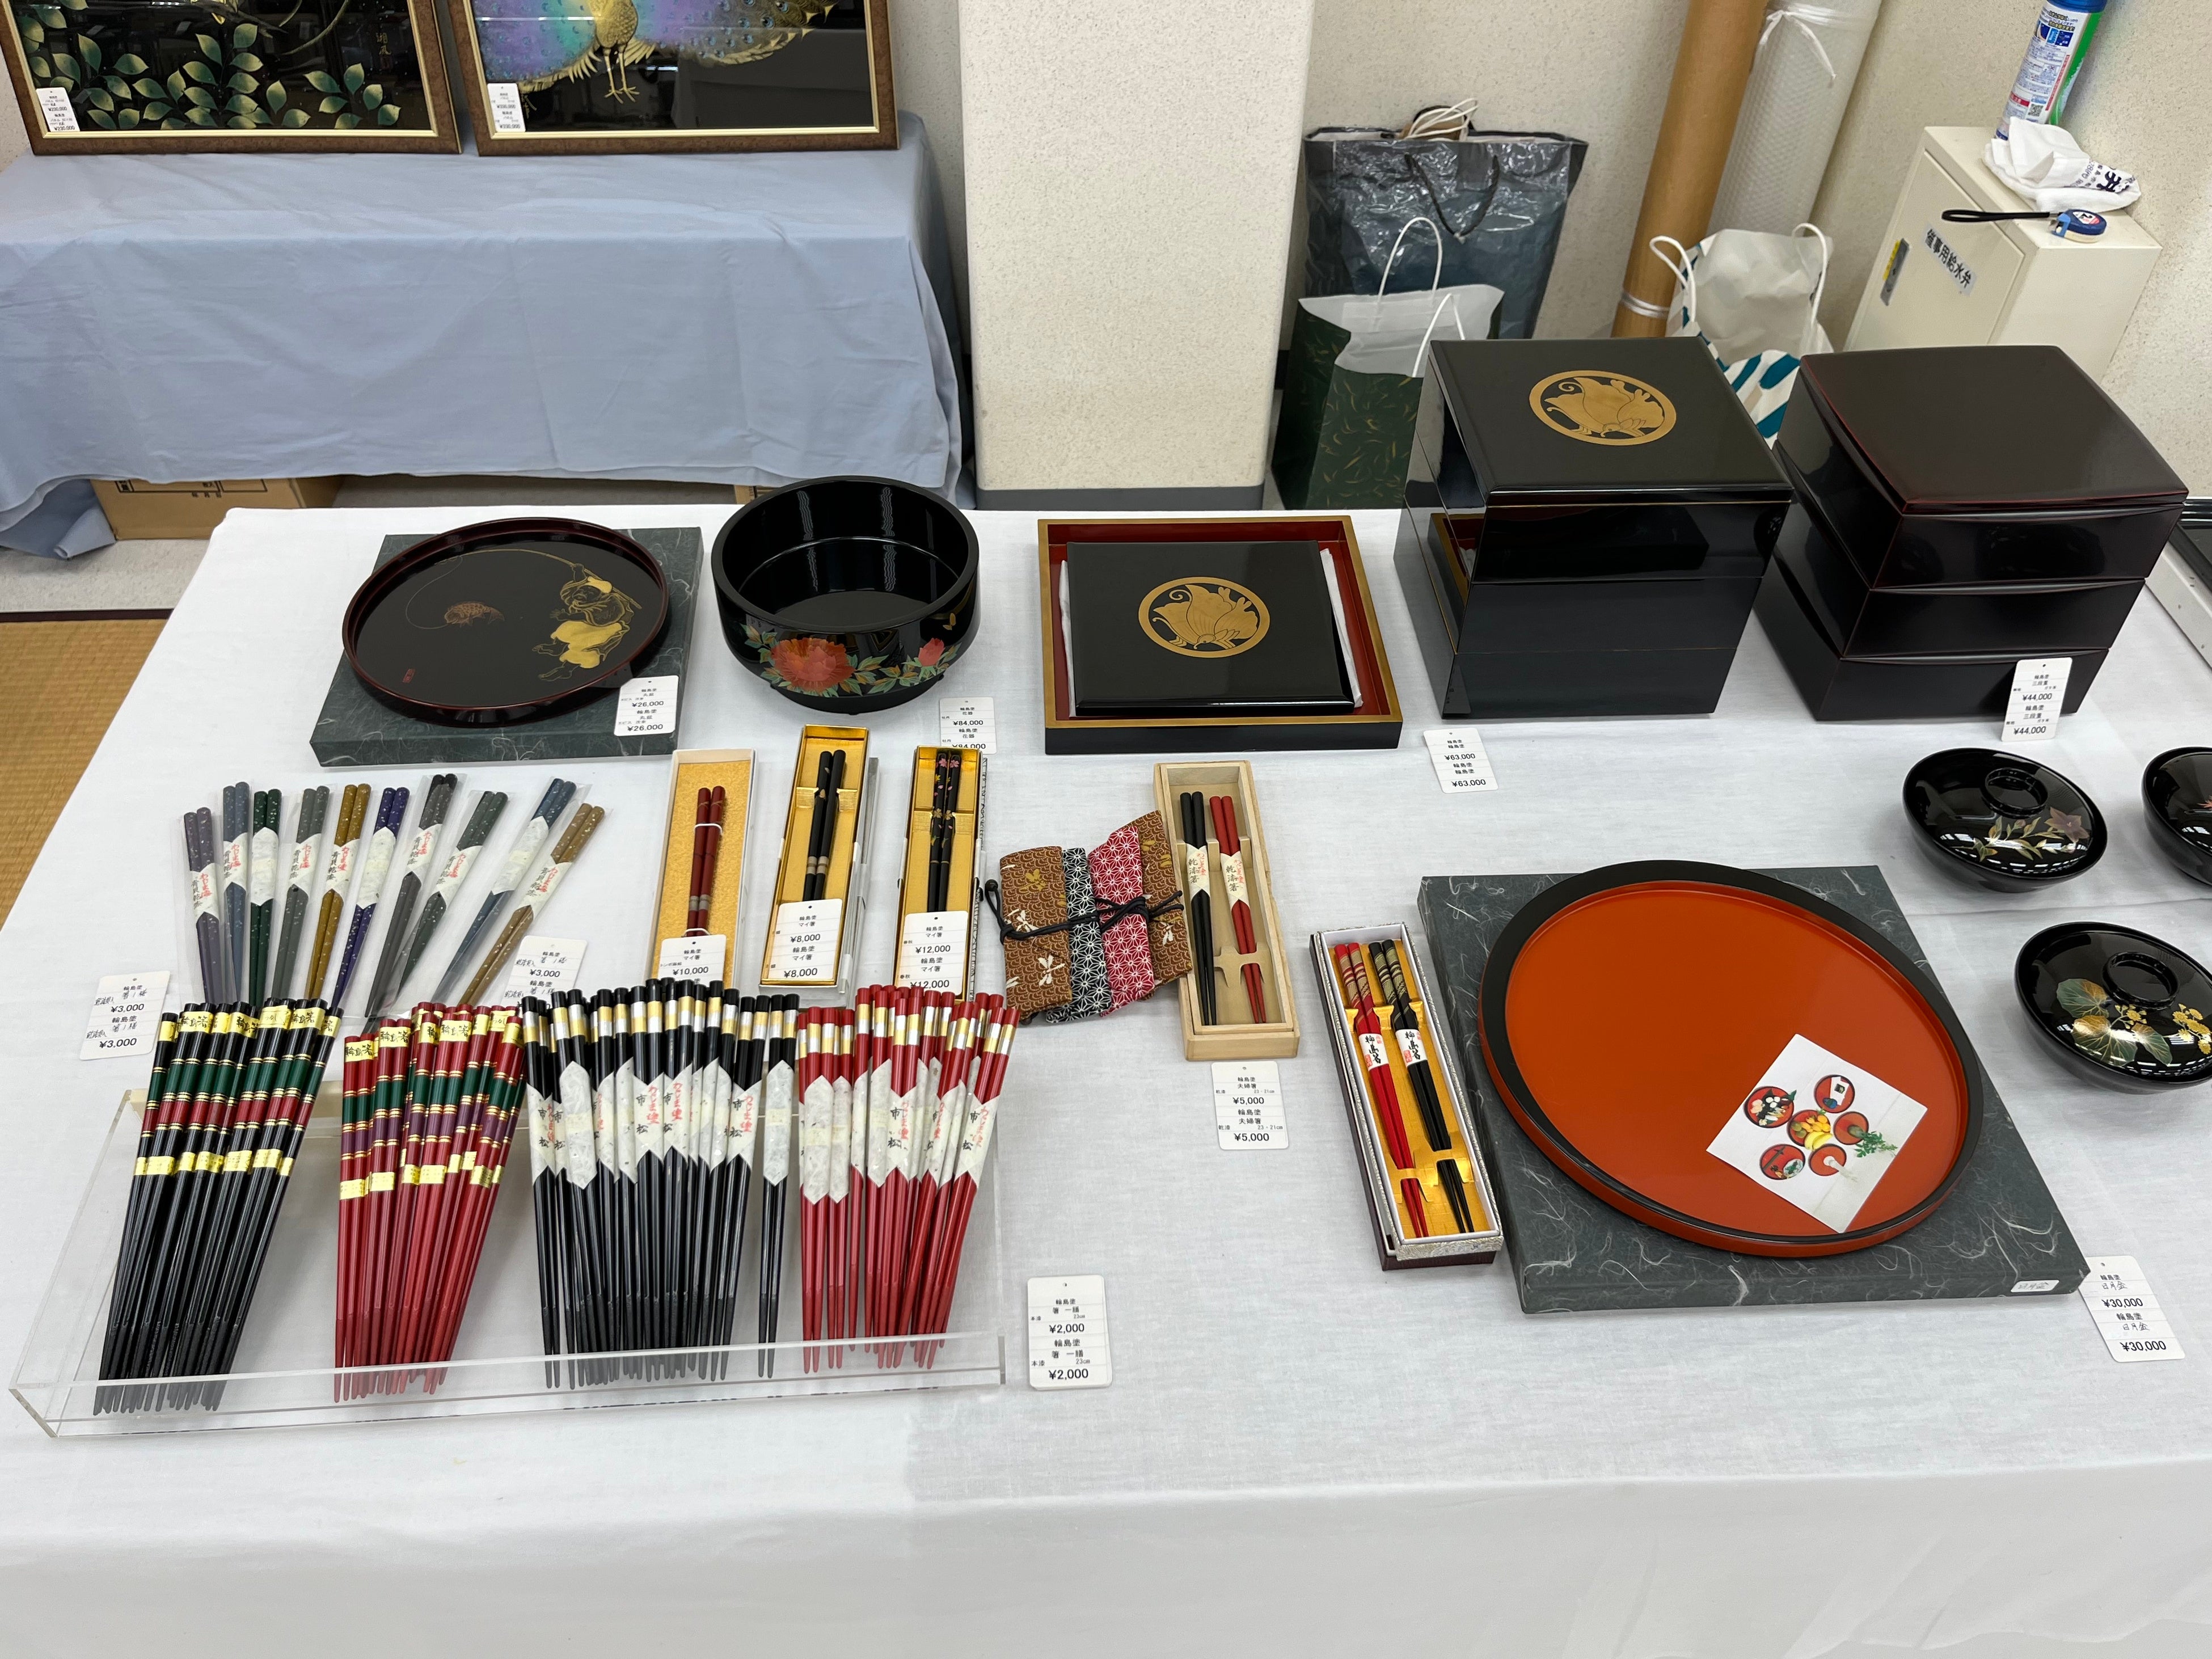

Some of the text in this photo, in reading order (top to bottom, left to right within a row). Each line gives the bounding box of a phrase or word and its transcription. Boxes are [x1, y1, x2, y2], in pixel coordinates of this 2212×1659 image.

[1925, 228, 1972, 289] 催事用給水弁
[2022, 693, 2053, 702] ¥44,000
[2013, 725, 2047, 735] ¥44,000
[1451, 779, 1486, 787] ¥63,000
[1188, 858, 1200, 884] 乾漆箸
[1226, 865, 1239, 892] 乾漆箸
[790, 934, 821, 943] ¥8,000
[915, 945, 951, 954] ¥12,000
[529, 968, 560, 977] ¥3,000
[672, 966, 709, 976] ¥10,000
[783, 968, 818, 978] ¥8,000
[910, 980, 950, 989] ¥12,000
[111, 1003, 145, 1013] ¥3,000
[99, 1037, 137, 1049] ¥3,000
[1233, 1133, 1270, 1142] ¥5,000
[2101, 1298, 2143, 1308] ¥30,000
[2116, 1312, 2143, 1321] 輪島塗
[1049, 1323, 1085, 1334] ¥2,000
[1054, 1338, 1080, 1348] 輪島塗
[2120, 1340, 2167, 1352] ¥30,000
[1048, 1368, 1089, 1380] ¥2,000
